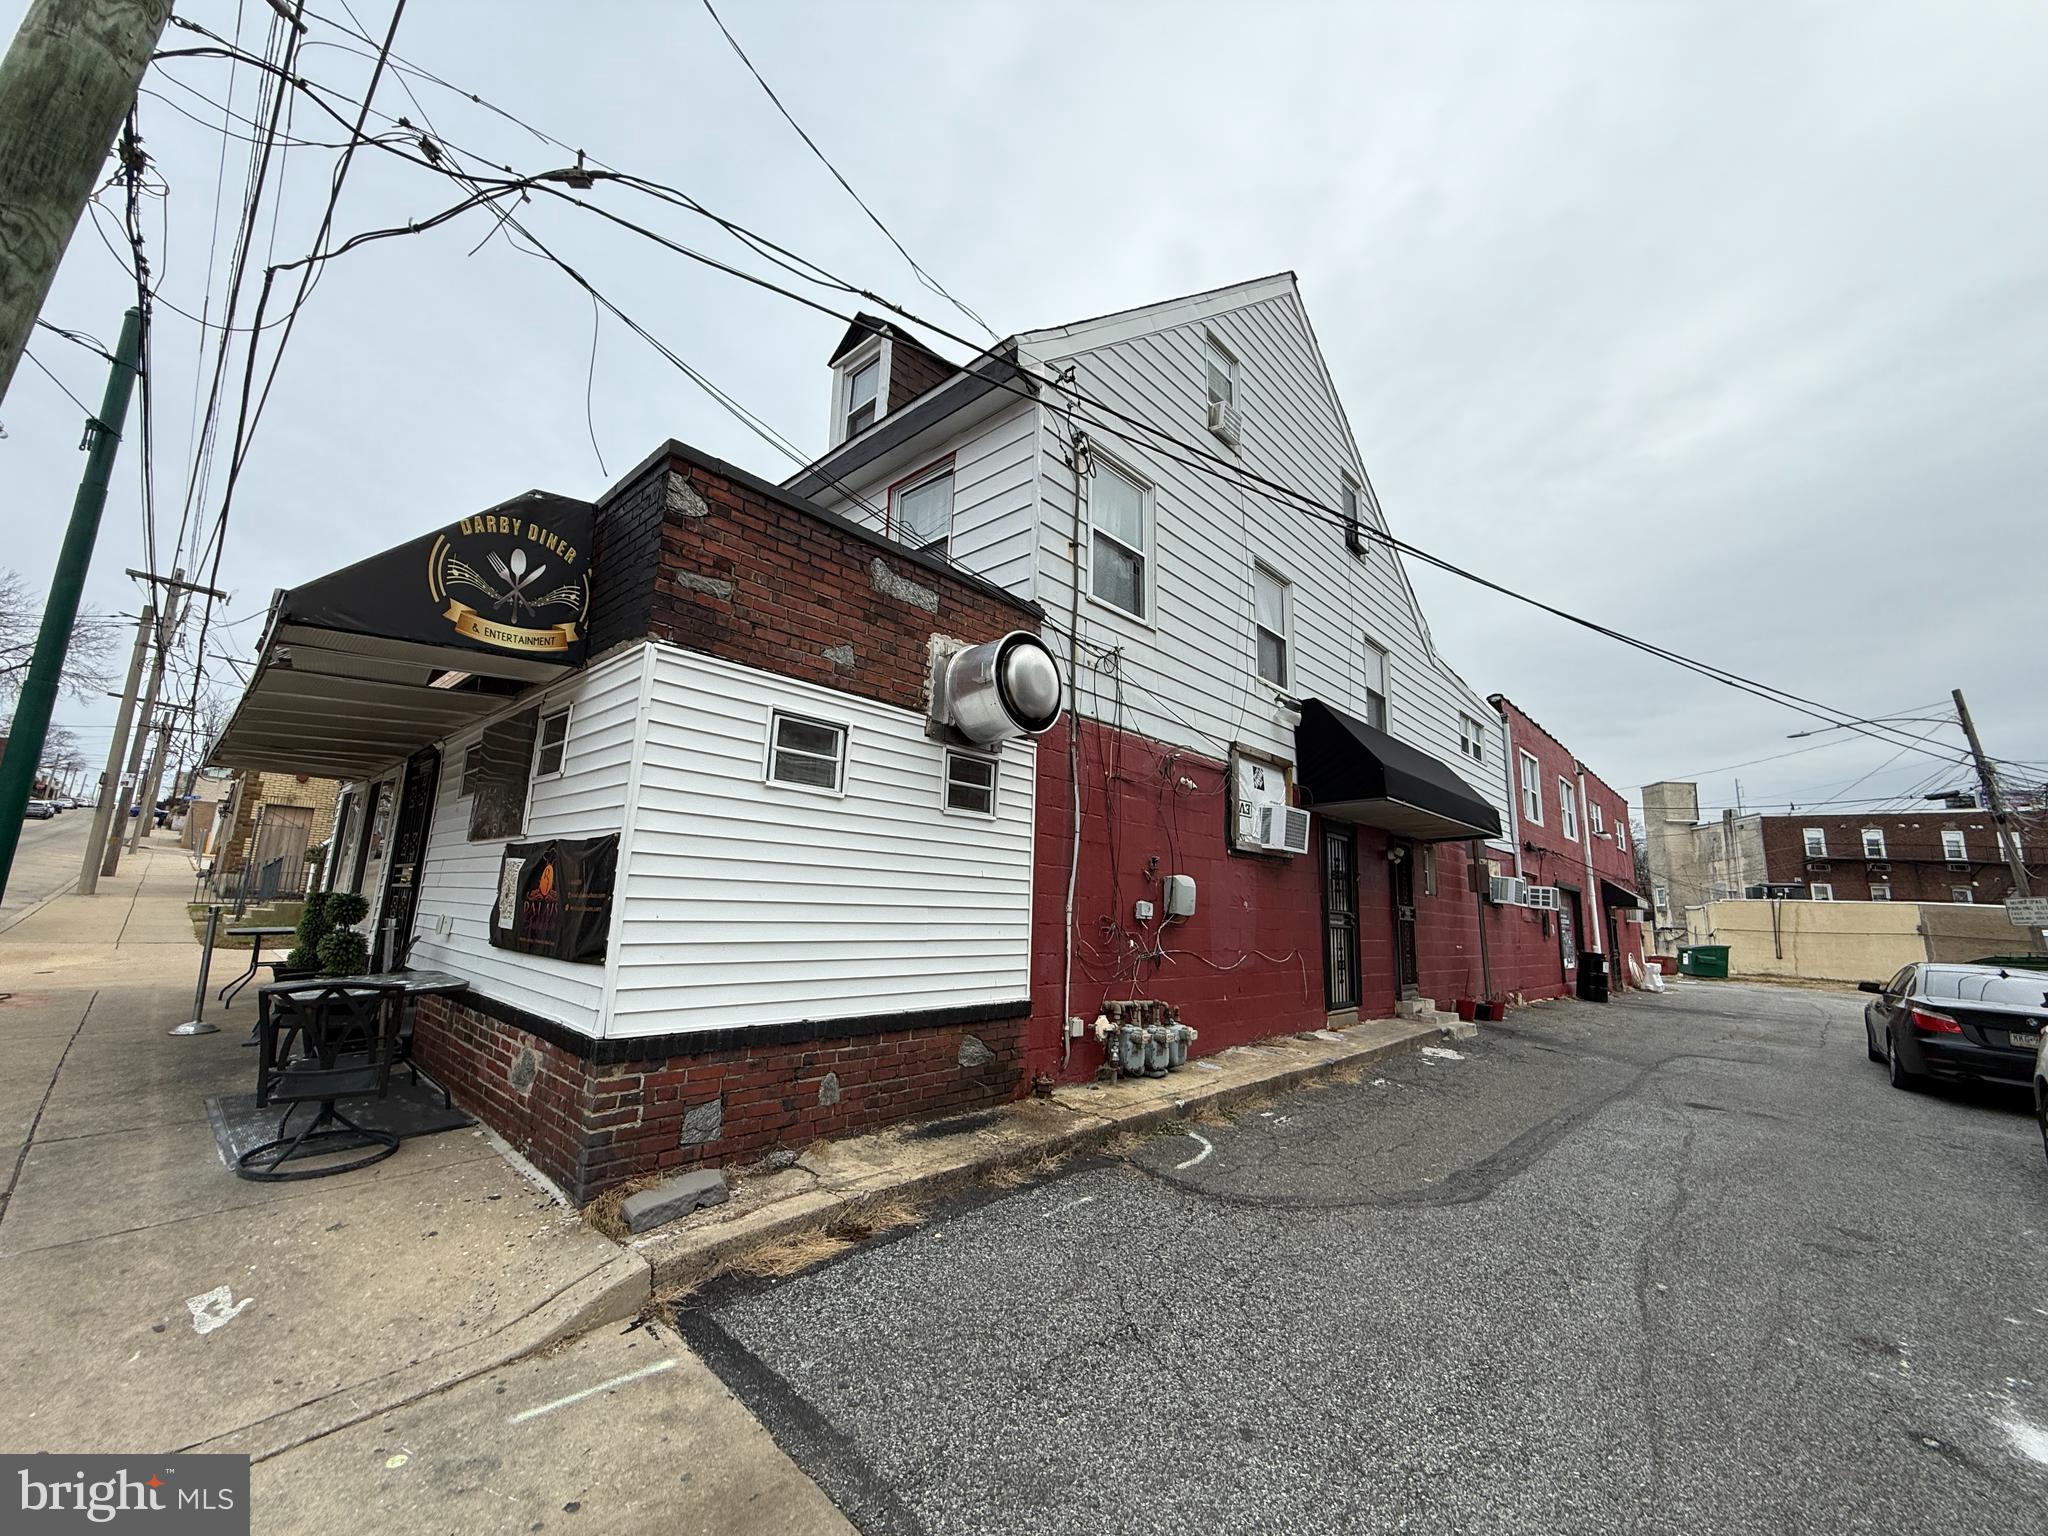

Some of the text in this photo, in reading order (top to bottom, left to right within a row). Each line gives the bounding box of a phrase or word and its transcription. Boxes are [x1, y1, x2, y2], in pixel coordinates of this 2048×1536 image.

[460, 516, 577, 565] DARBY DINER
[472, 622, 556, 646] & ENTERTAINMENT
